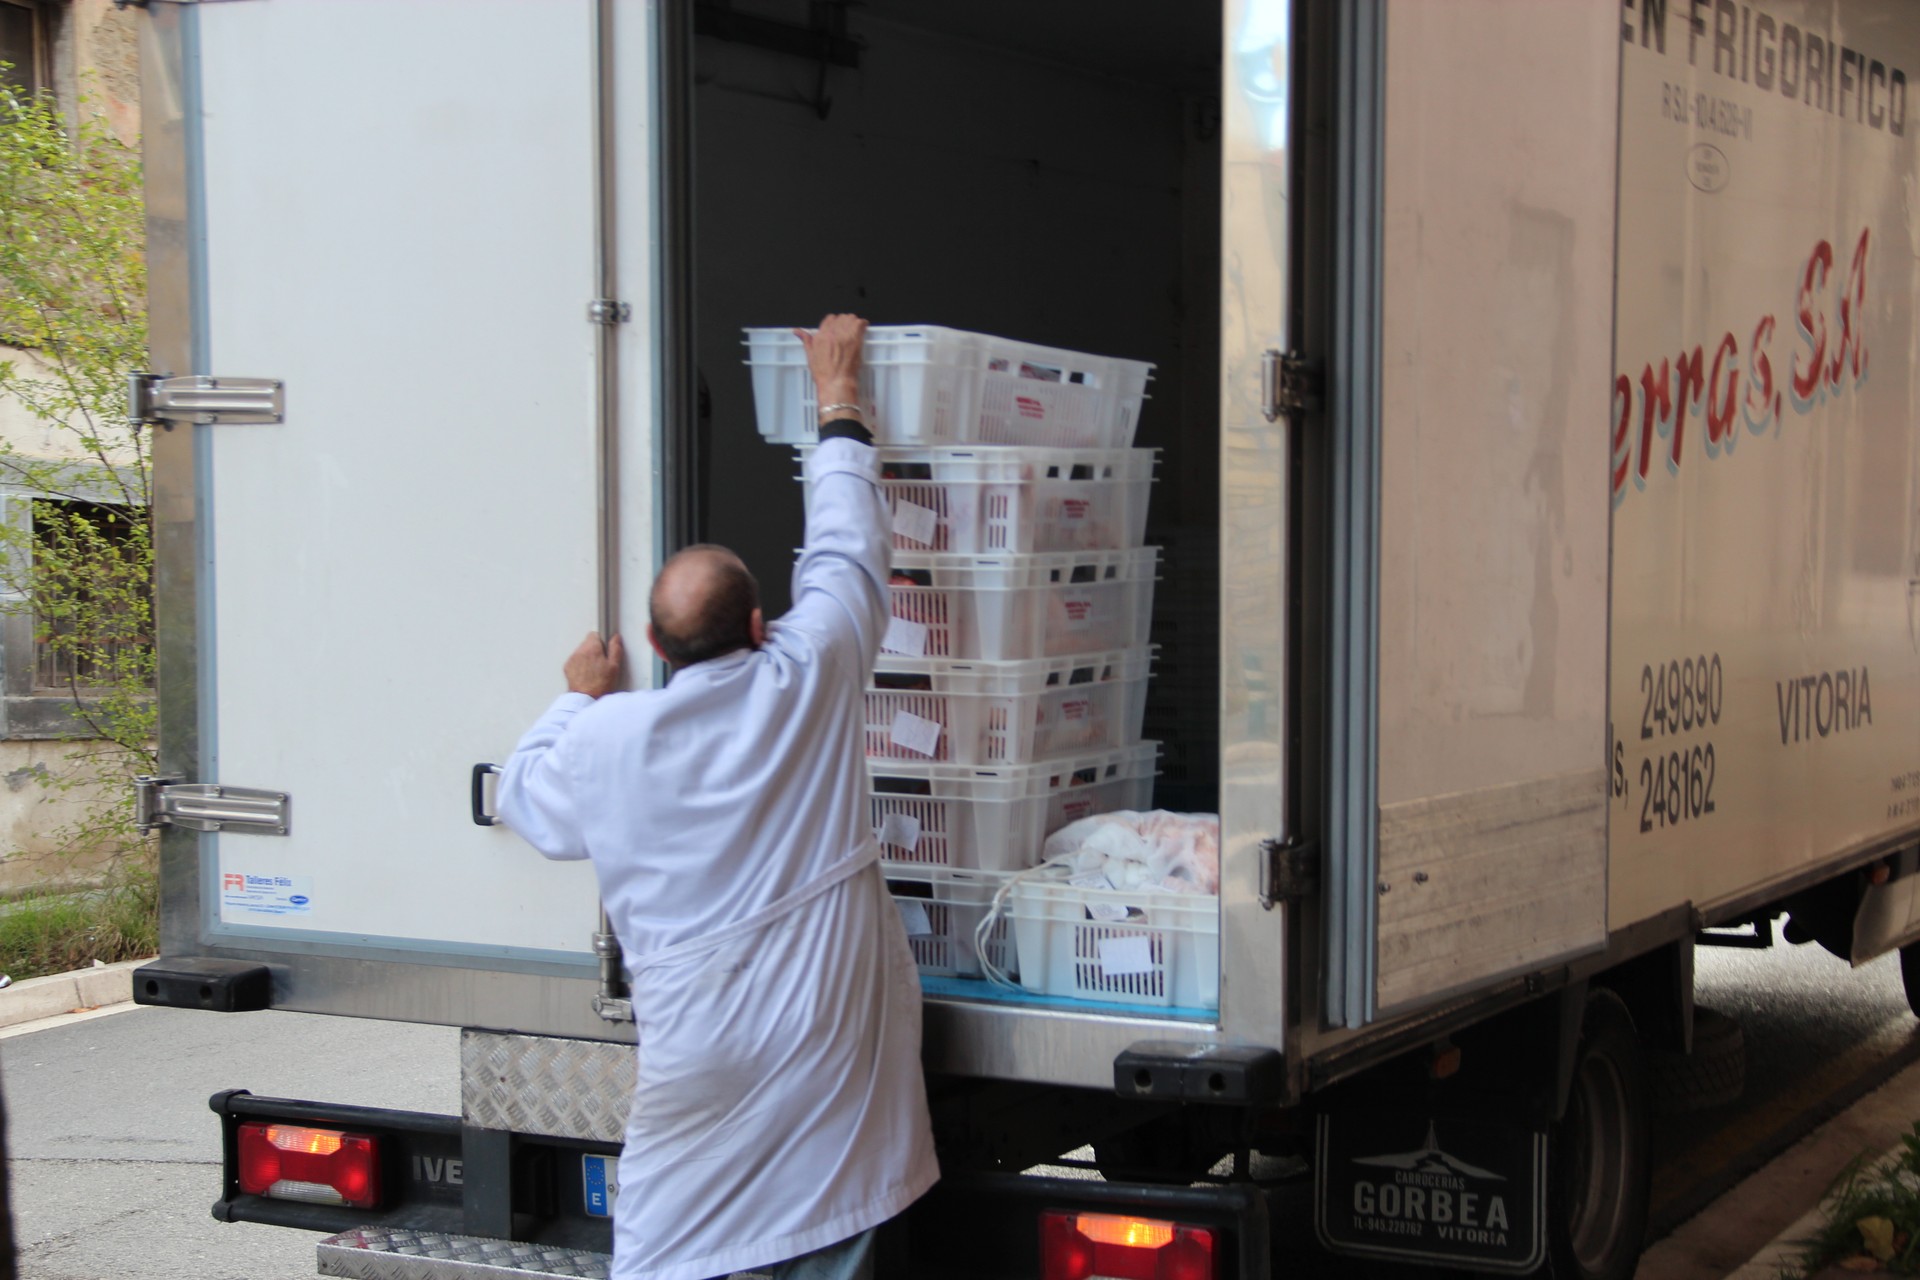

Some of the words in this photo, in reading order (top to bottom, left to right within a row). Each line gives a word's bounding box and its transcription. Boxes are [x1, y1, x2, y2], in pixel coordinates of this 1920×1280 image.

[1689, 0, 1907, 137] FRIGORIFICO
[1640, 652, 1723, 740] 249890
[1776, 665, 1872, 745] VITORIA
[1640, 742, 1716, 834] 248162
[592, 1192, 602, 1206] E
[1354, 1181, 1509, 1230] GORBEA
[1396, 1171, 1465, 1191] CARROCERIAS
[1438, 1225, 1507, 1247] VITORIA
